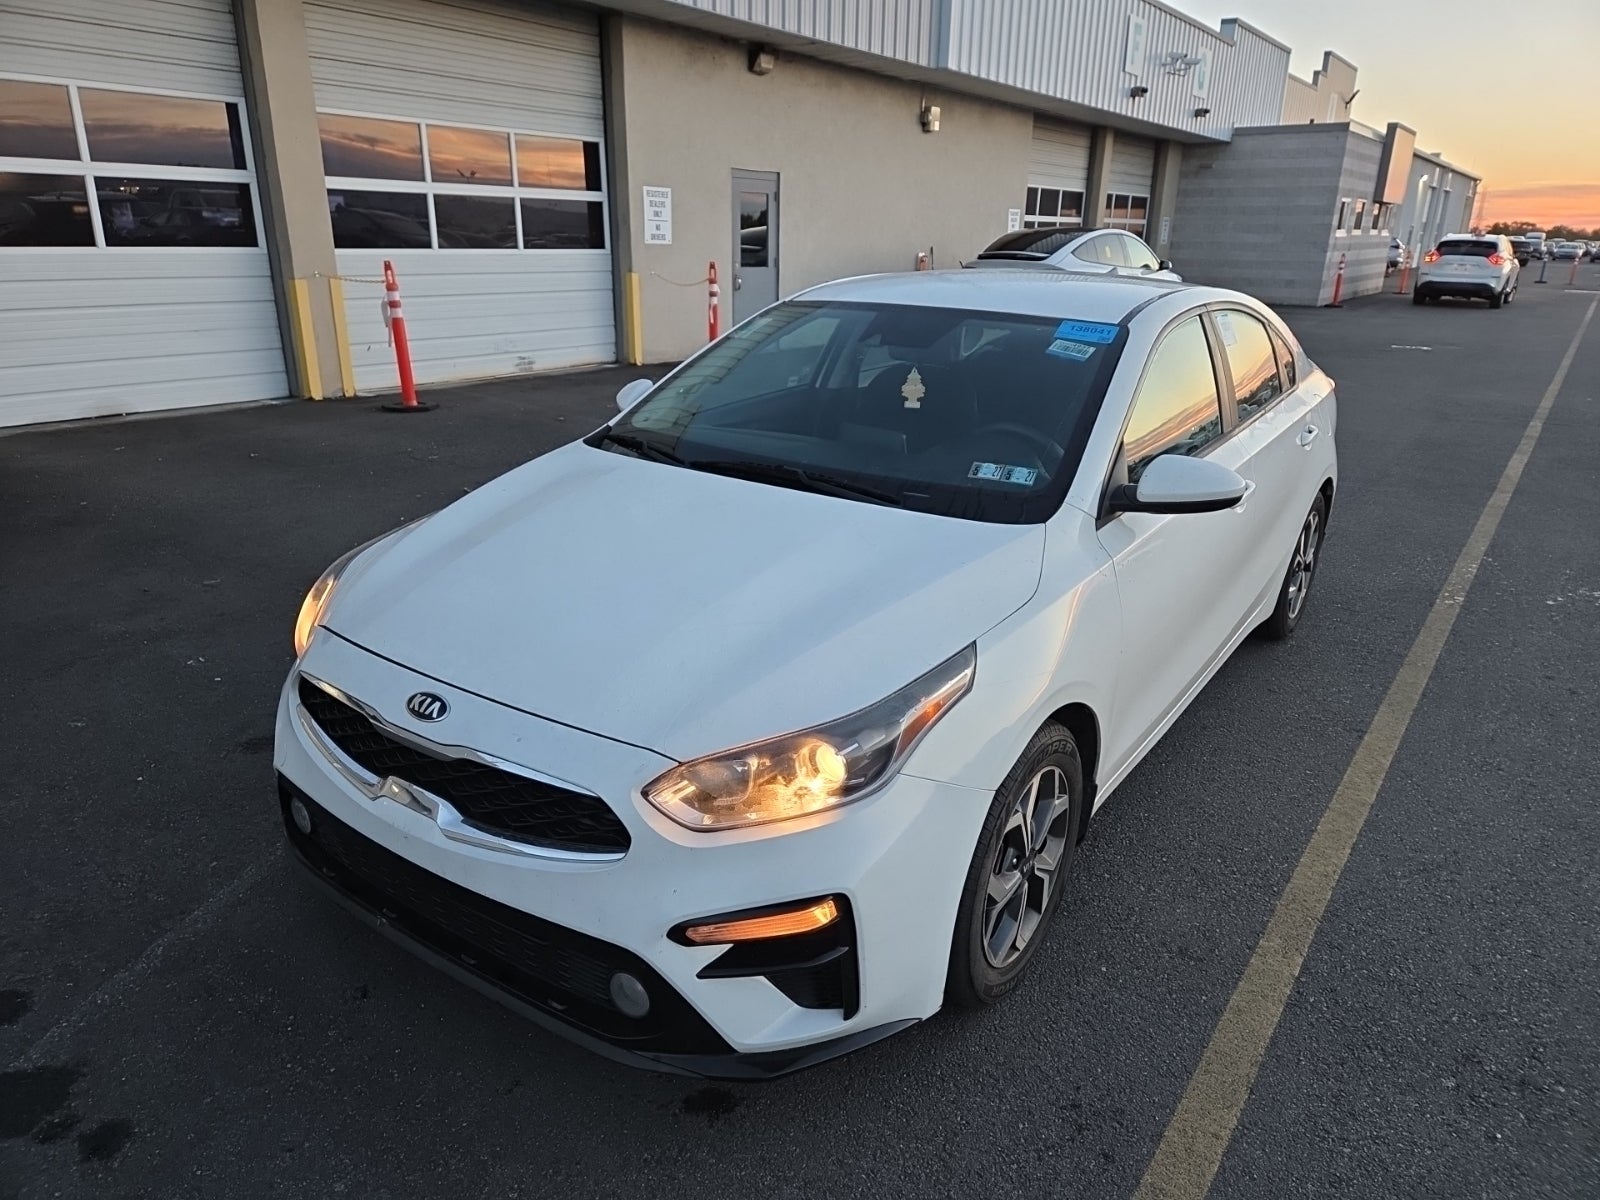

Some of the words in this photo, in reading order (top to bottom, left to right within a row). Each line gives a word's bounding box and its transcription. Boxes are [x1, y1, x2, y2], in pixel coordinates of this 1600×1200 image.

[1070, 325, 1112, 336] 138041
[992, 466, 1002, 477] 27
[1025, 471, 1035, 482] 27
[409, 694, 442, 718] KIA
